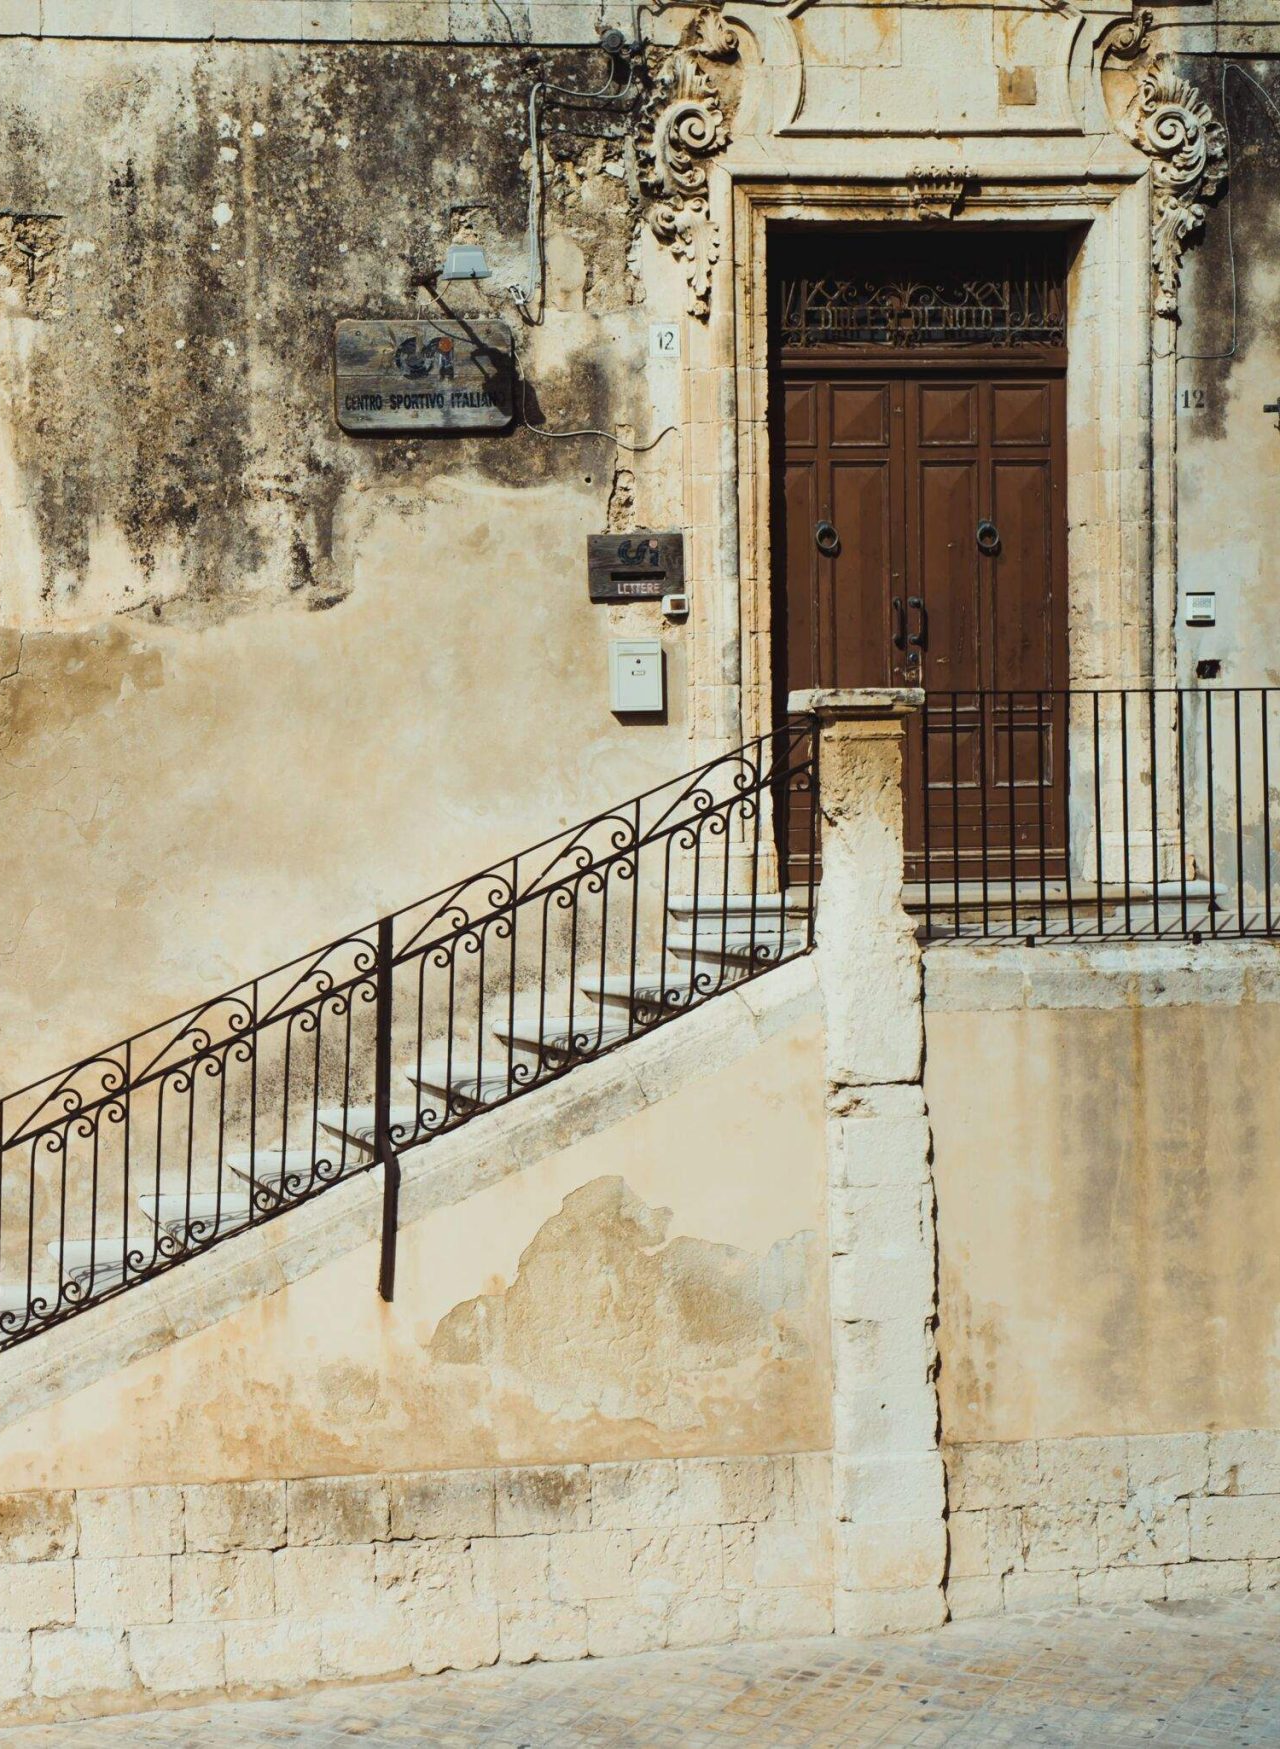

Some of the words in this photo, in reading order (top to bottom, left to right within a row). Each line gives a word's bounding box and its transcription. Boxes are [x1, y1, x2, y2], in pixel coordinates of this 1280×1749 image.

[656, 331, 674, 350] 12
[344, 394, 382, 411] CENTRO
[390, 393, 445, 410] SPORTIVO
[1181, 389, 1205, 409] 12
